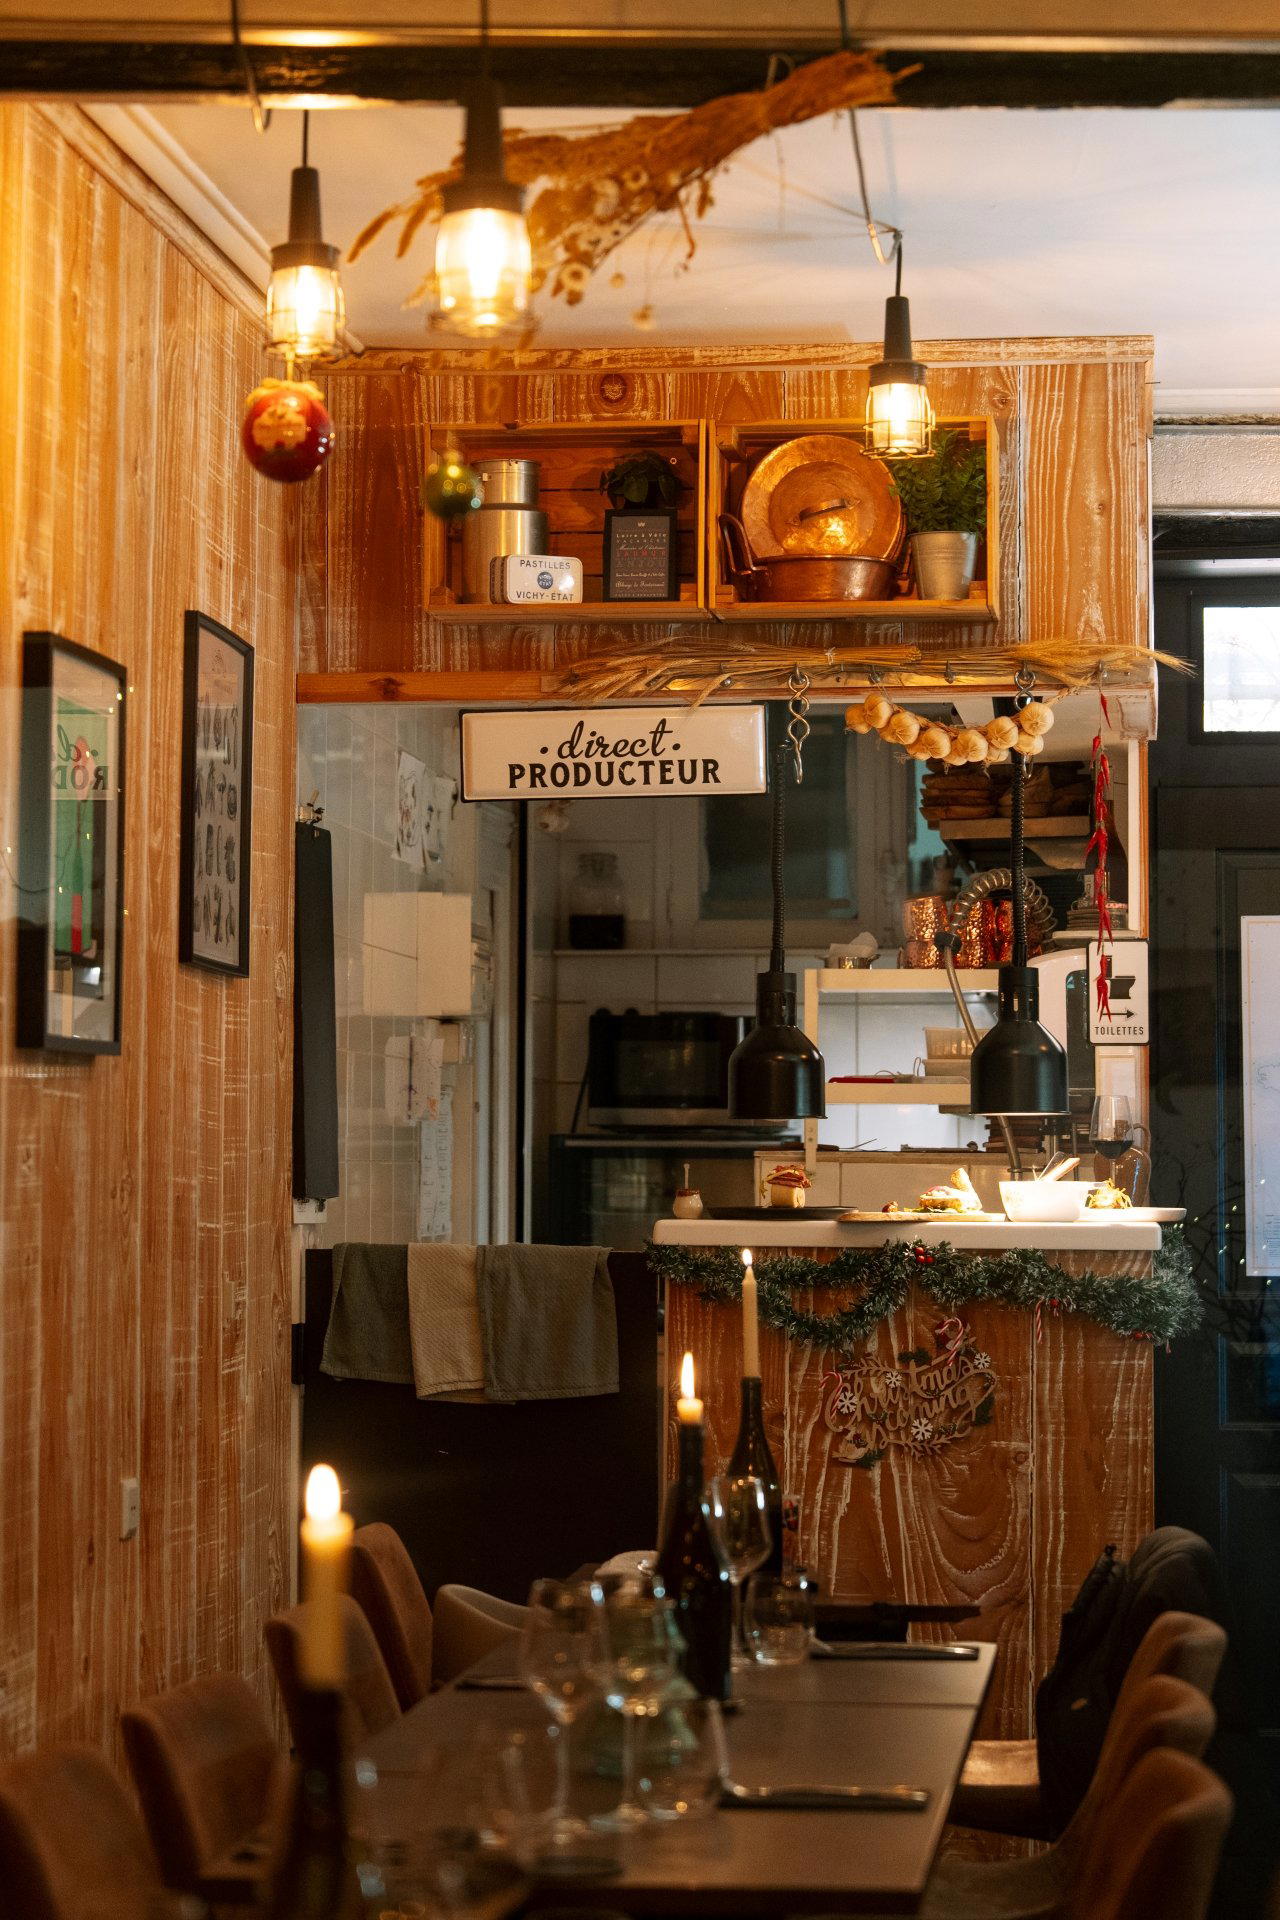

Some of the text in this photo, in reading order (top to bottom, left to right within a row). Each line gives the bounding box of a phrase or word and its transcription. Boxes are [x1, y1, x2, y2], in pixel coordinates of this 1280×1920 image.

[520, 559, 571, 570] PASTILLES
[557, 718, 674, 760] direct
[508, 758, 721, 789] PRODUCTEUR
[1095, 1026, 1144, 1036] TOILETTES
